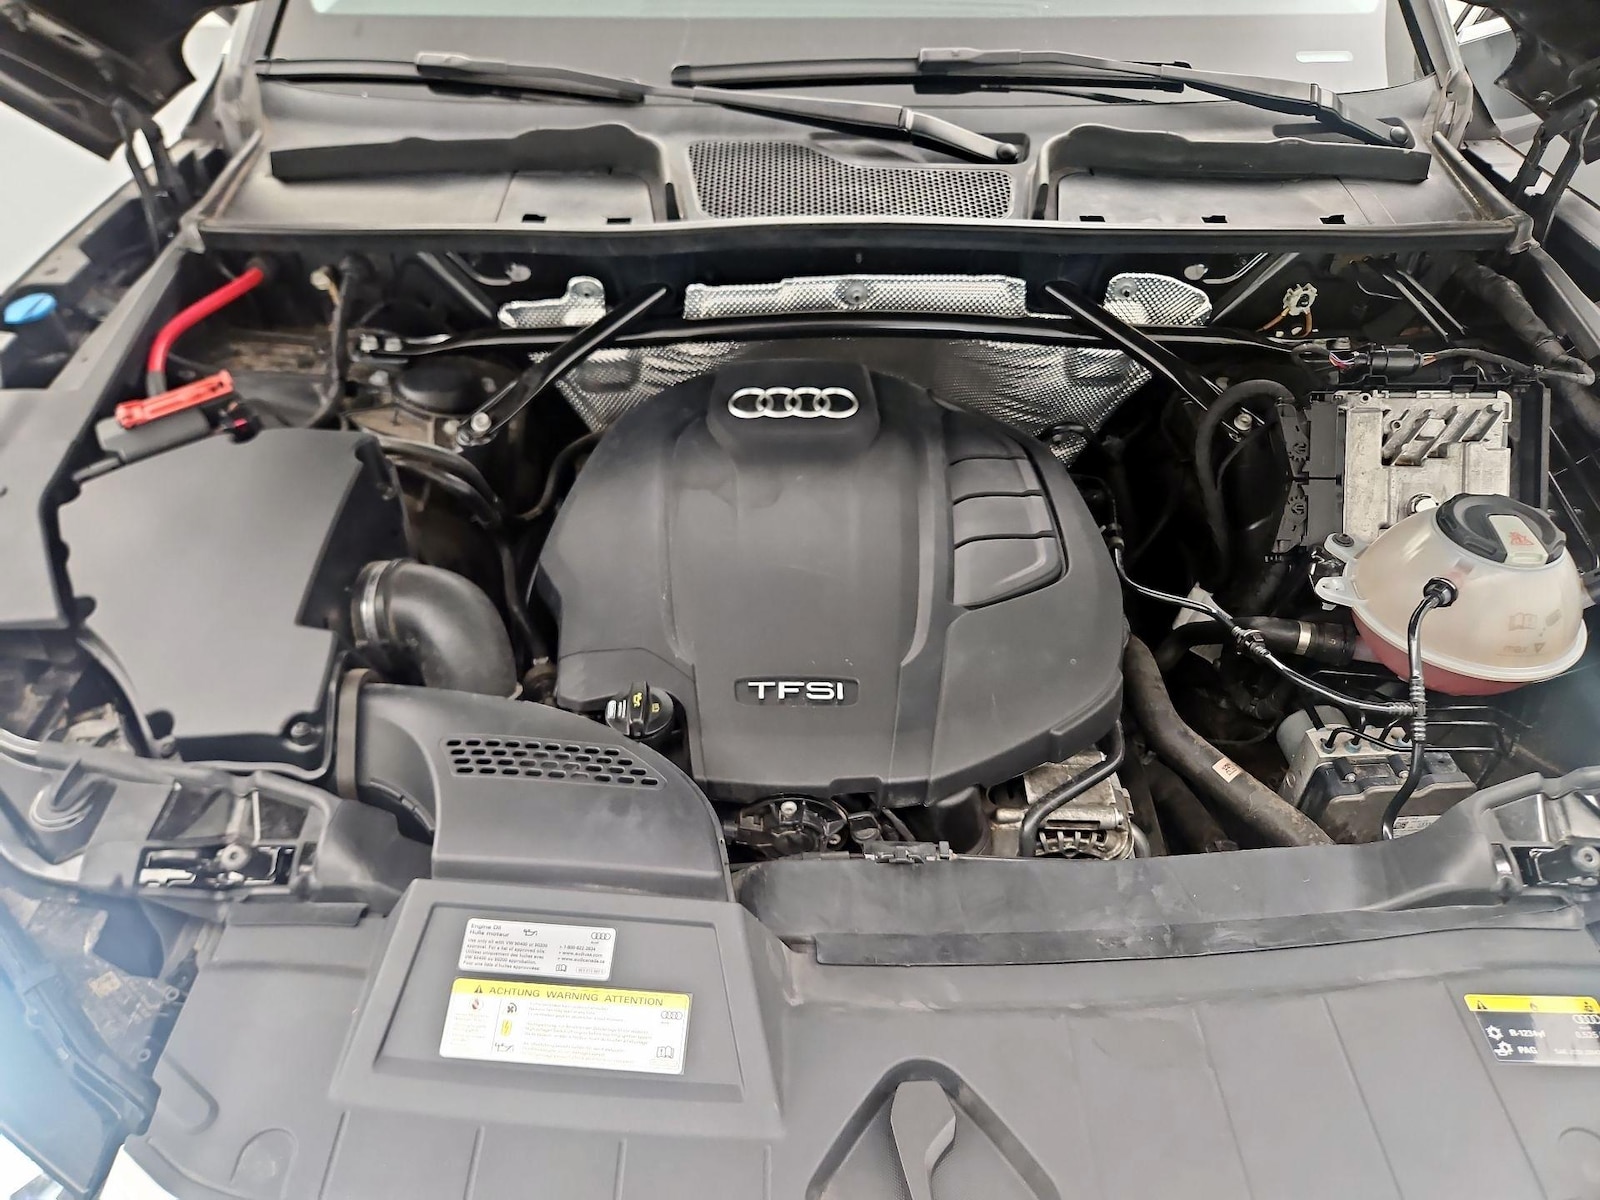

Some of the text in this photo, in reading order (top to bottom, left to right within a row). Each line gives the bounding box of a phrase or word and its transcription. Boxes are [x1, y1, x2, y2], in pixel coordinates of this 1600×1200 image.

[748, 681, 844, 700] TFSI
[489, 986, 664, 1006] ACHTUNG WARNING ATTENTION
[1517, 1046, 1538, 1054] PAG
